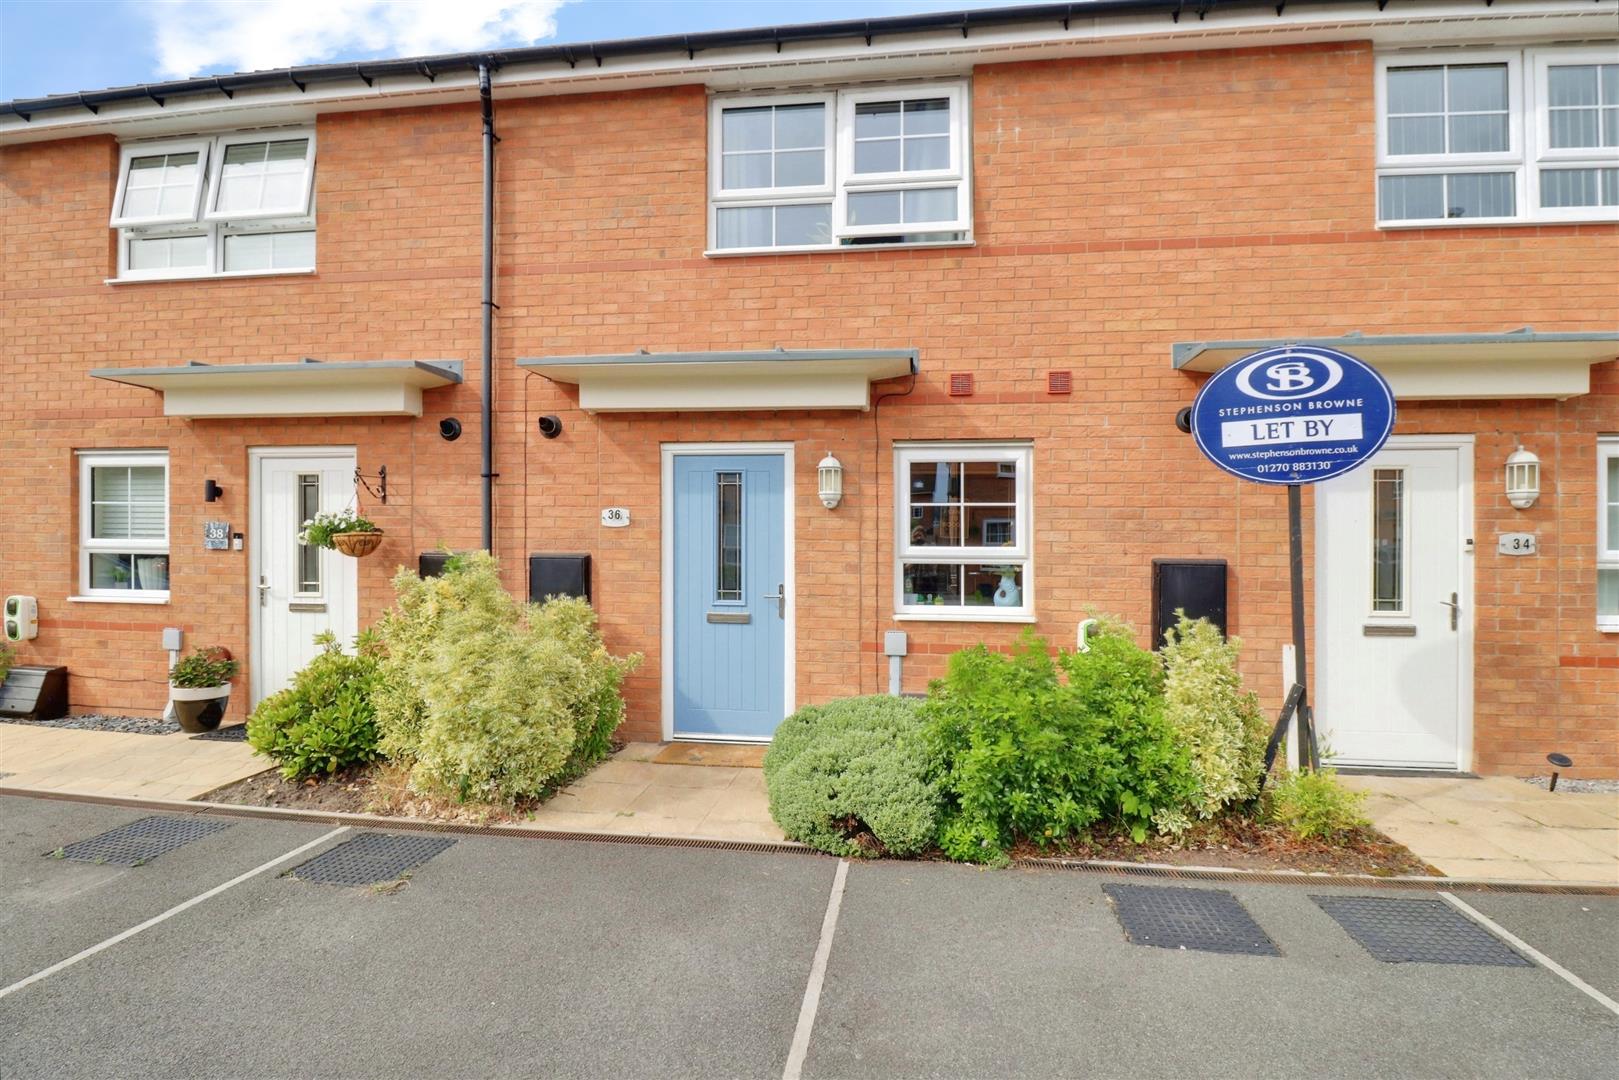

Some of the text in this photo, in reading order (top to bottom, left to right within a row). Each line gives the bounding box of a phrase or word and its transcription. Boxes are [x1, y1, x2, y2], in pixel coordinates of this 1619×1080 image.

[1218, 398, 1364, 417] STEPHENSON BROWNE
[1250, 420, 1333, 441] LET BY
[1228, 445, 1359, 461] www.stephensonbrowne.co.uk
[1257, 461, 1331, 473] 01270 883130
[608, 509, 621, 520] 36
[209, 528, 224, 539] 38
[1513, 538, 1530, 550] 34
